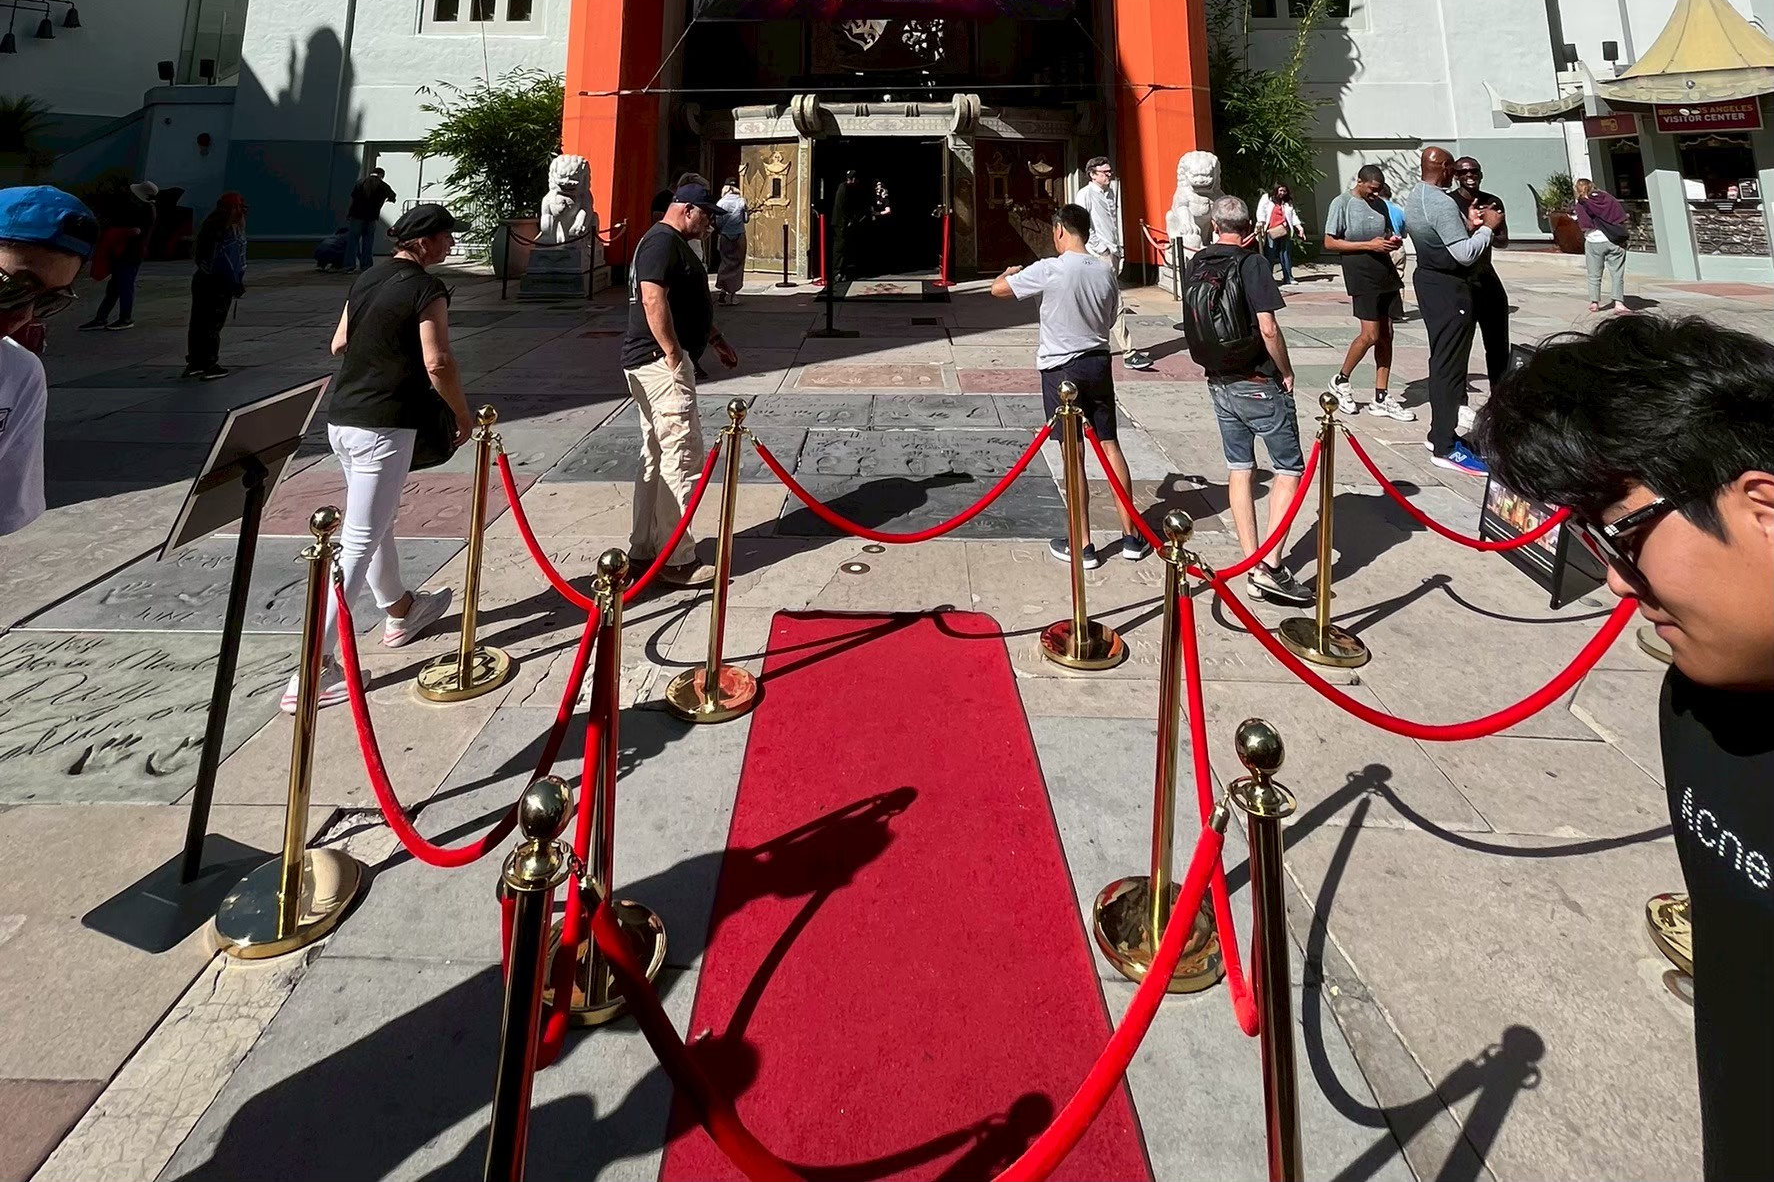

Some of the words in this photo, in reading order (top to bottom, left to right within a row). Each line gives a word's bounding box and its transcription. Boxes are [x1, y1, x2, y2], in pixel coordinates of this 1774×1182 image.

[1709, 104, 1754, 113] ANGELES
[1663, 114, 1702, 123] VISITOR
[1704, 113, 1745, 122] CENTER
